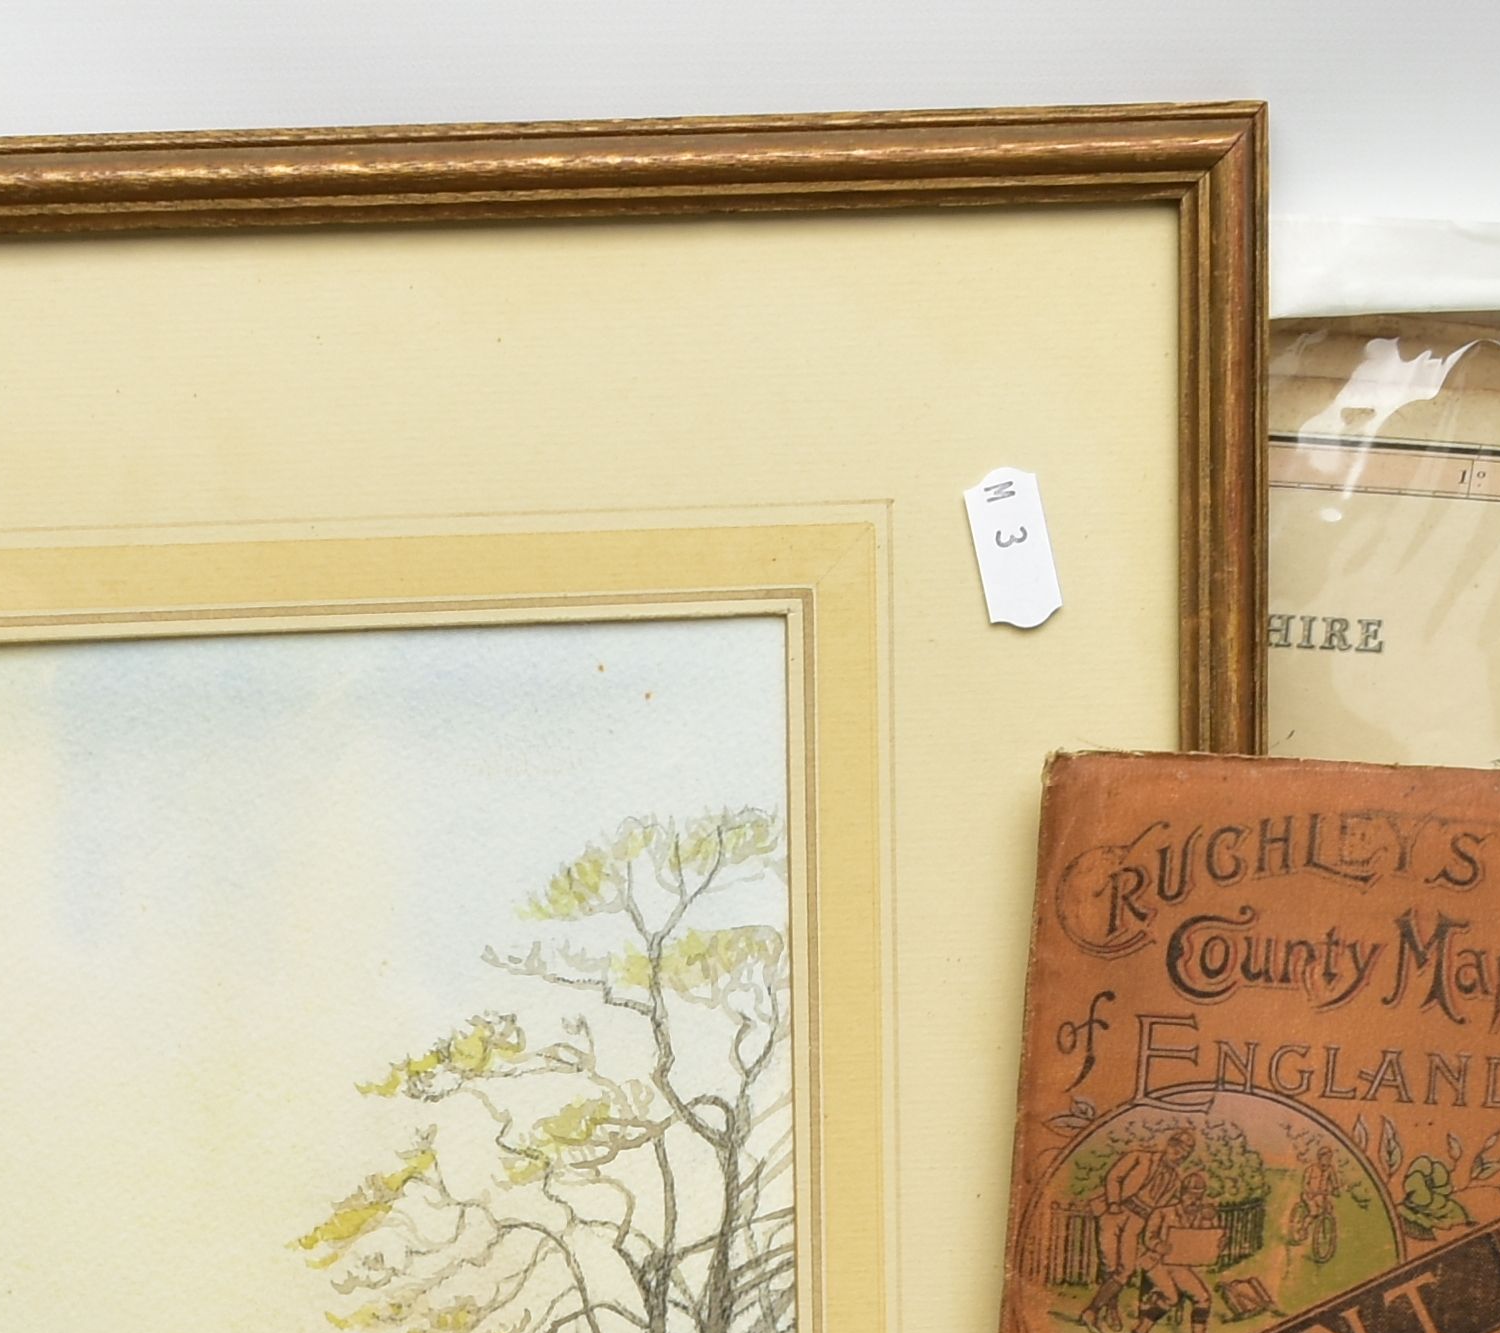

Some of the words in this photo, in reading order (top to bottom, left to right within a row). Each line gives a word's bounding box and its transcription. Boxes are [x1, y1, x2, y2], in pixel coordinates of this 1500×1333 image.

[995, 525, 1028, 548] 3
[1165, 906, 1383, 1011] County
[1057, 991, 1114, 1093] of
